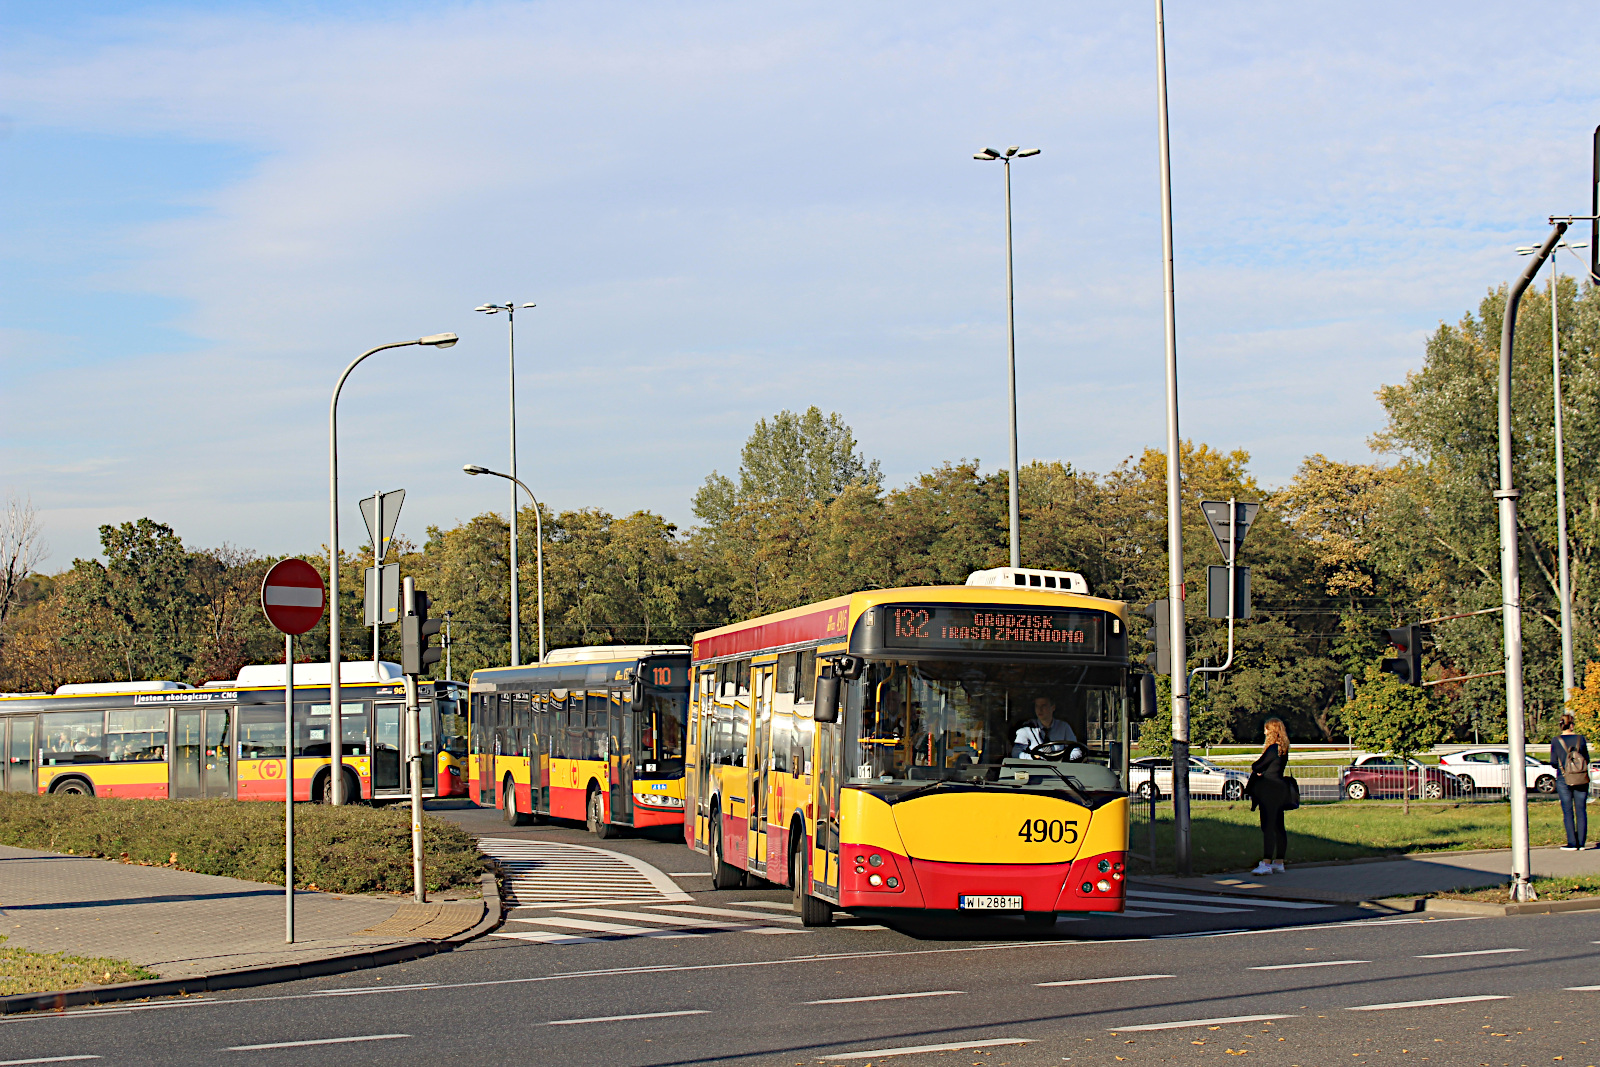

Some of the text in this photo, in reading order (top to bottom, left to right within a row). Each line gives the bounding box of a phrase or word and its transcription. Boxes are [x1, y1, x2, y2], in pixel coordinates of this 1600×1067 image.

[893, 608, 930, 638] 132
[974, 613, 1053, 629] GRODZISK
[940, 625, 1084, 643] TRASA ZMIENIONA
[653, 667, 671, 685] 110
[166, 693, 212, 702] ekologiczny
[221, 691, 238, 699] CNG
[1018, 819, 1079, 844] 4905
[986, 897, 1021, 908] 2881H
